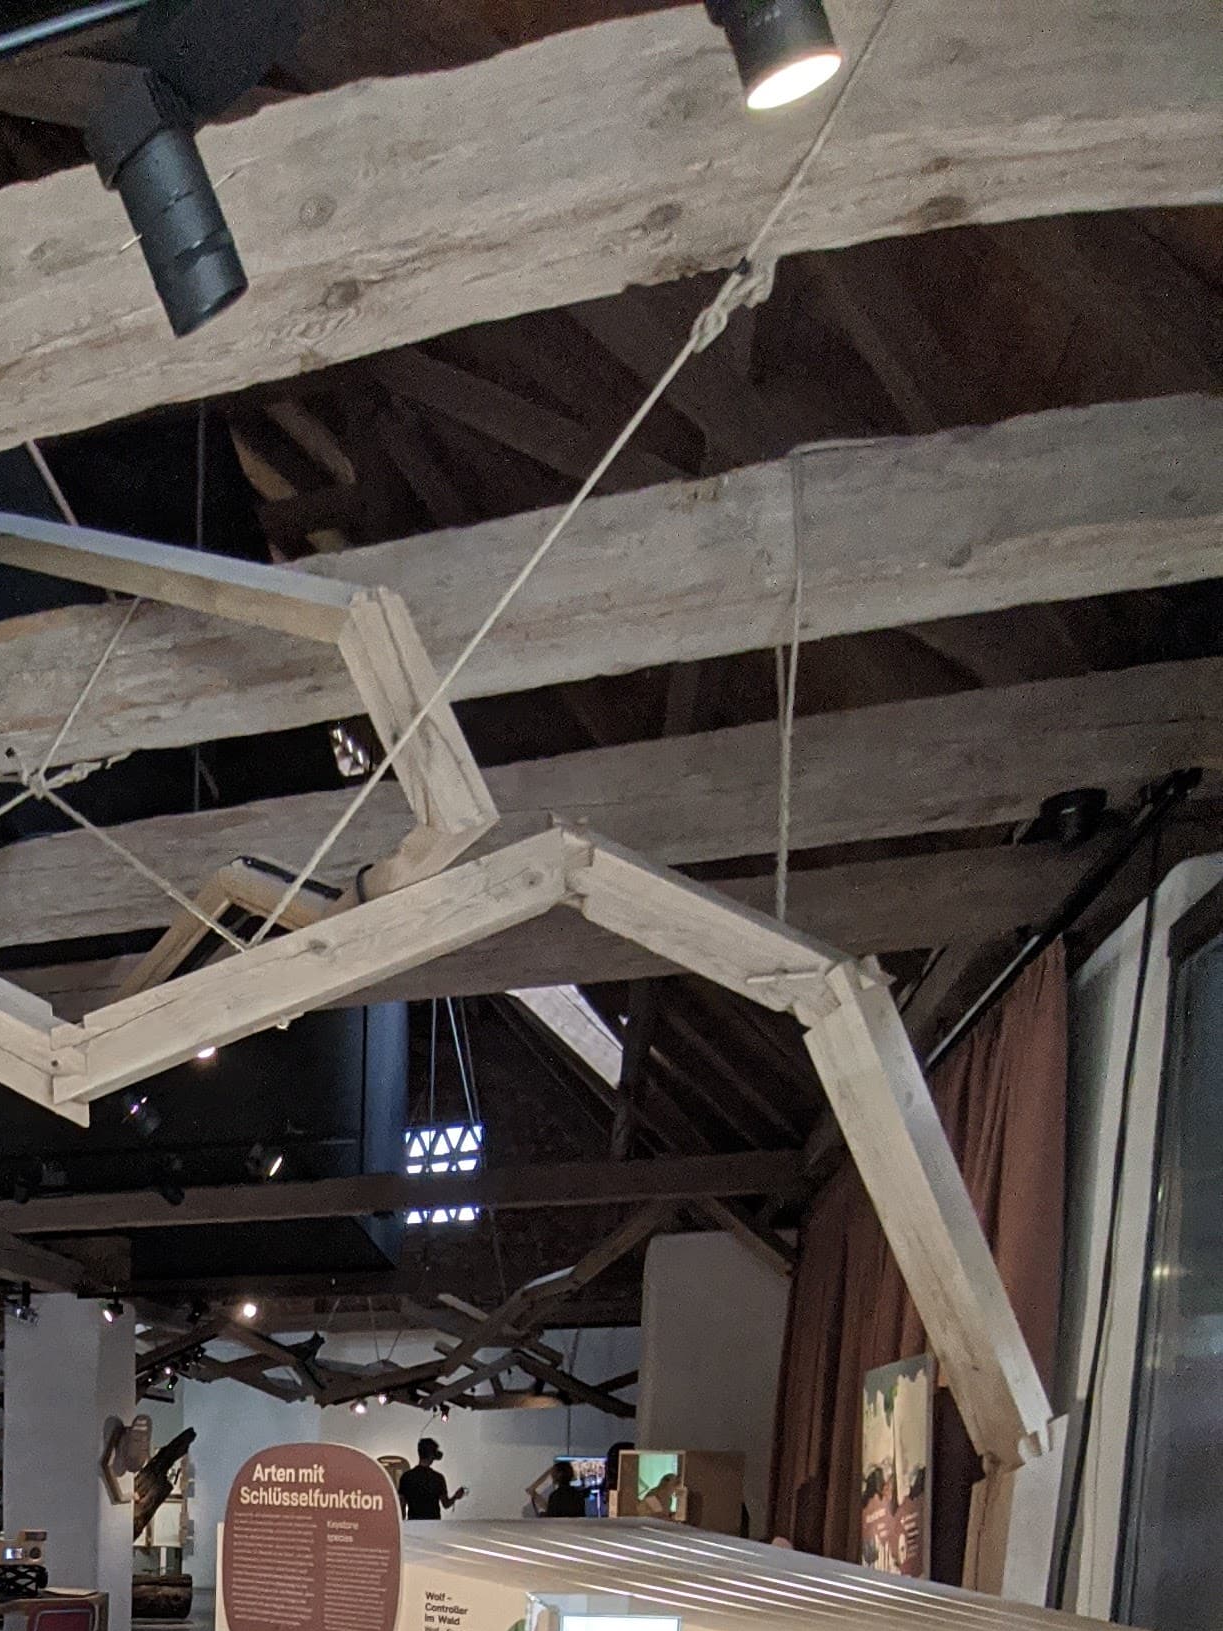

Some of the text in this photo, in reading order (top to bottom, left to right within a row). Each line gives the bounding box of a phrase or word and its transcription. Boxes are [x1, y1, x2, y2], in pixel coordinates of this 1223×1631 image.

[252, 1463, 325, 1483] Arten mit
[240, 1486, 383, 1511] Schlüsselfunktion
[425, 1591, 445, 1601] Wolf
[425, 1602, 468, 1615] Controller
[438, 1615, 460, 1625] Wald
